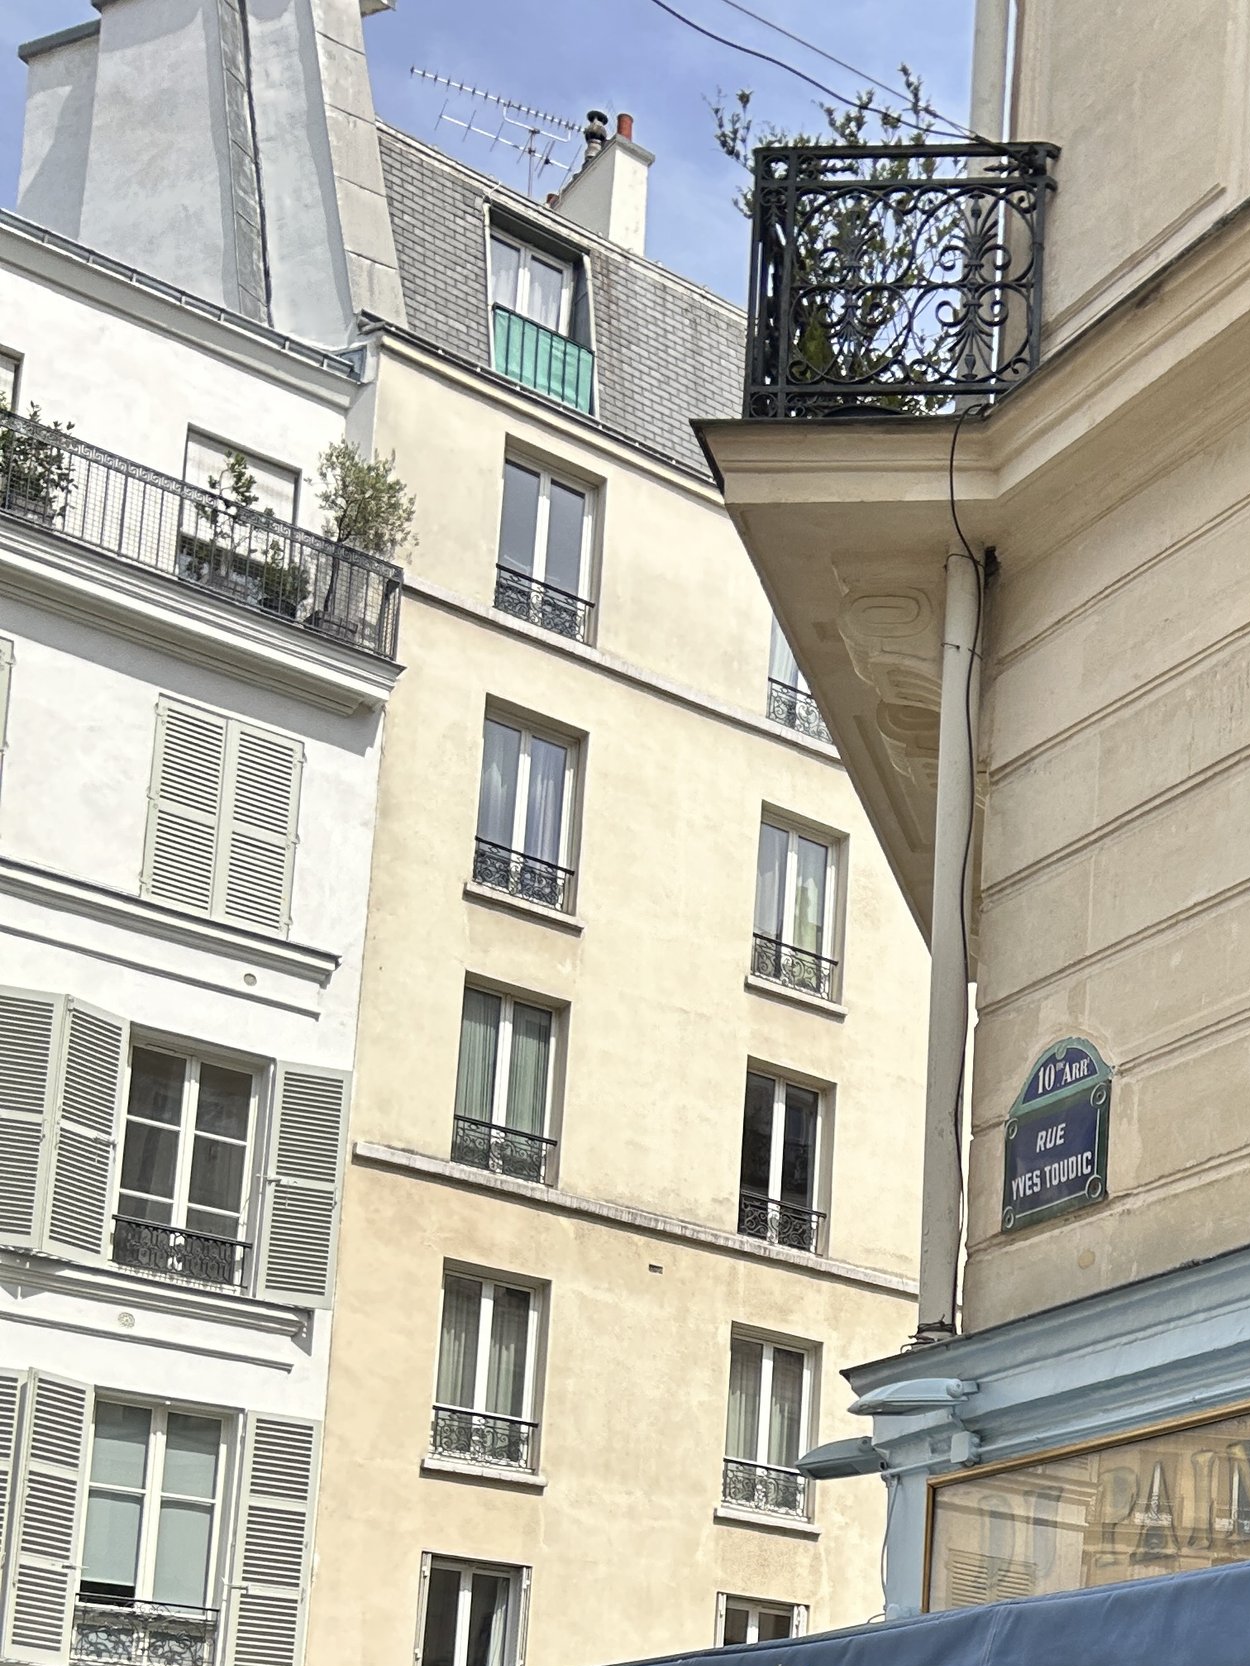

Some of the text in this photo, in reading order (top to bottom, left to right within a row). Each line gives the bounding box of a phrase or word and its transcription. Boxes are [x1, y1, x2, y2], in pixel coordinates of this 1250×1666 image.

[1036, 1122, 1066, 1153] RUE
[1011, 1151, 1092, 1200] YVES TOUDIC
